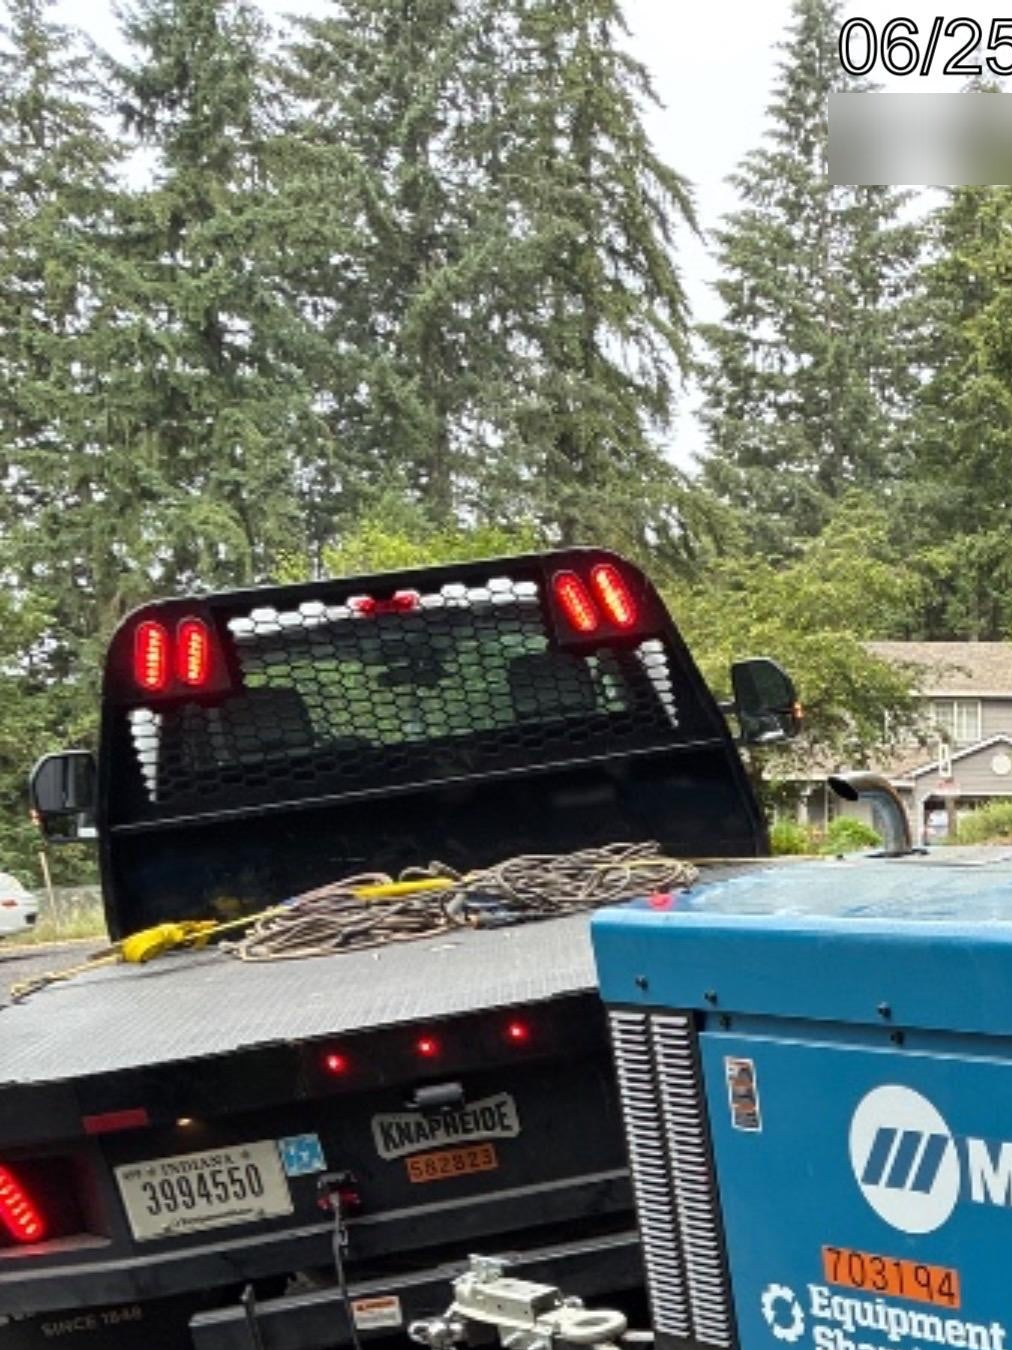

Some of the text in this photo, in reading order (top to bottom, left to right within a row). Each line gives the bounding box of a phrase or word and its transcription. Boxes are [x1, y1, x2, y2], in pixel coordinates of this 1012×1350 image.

[379, 1101, 513, 1152] KNAPHEIDE
[143, 1164, 264, 1216] 3994550
[160, 1153, 234, 1177] INDIANA
[826, 1247, 956, 1305] 703194
[41, 1314, 97, 1338] SINCE
